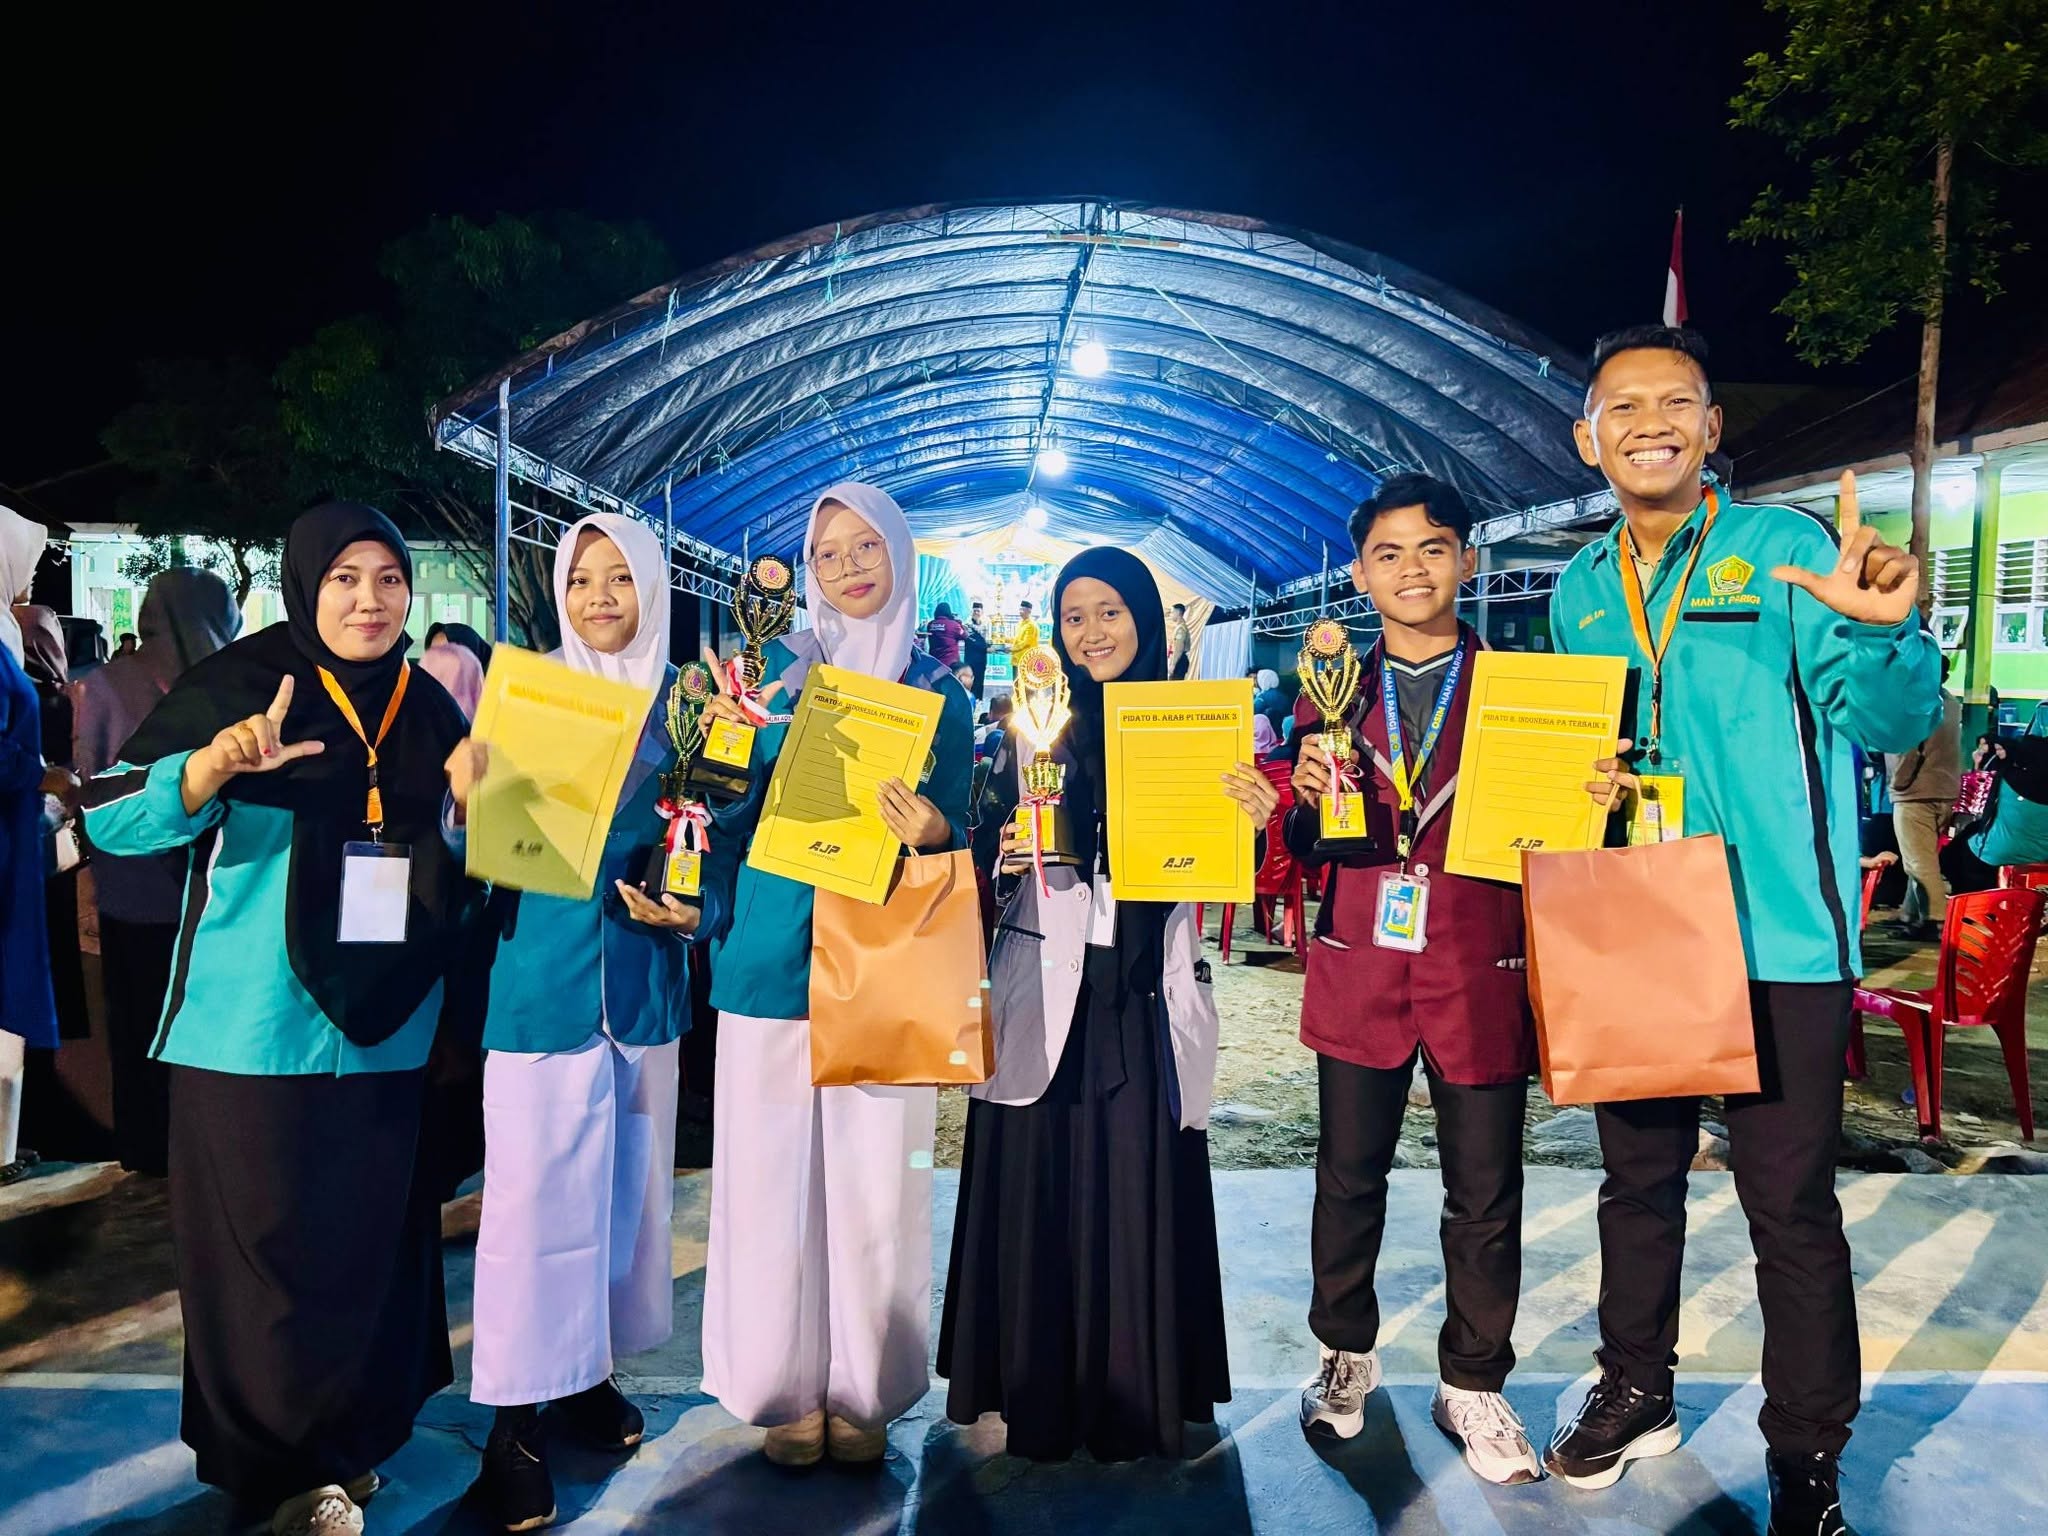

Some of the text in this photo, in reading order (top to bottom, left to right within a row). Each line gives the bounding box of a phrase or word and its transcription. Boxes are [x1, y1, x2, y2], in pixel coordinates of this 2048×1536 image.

[1690, 597, 1715, 608] MAN
[1718, 597, 1725, 605] 2
[1384, 672, 1394, 691] MAN
[1439, 684, 1454, 706] MAN
[1122, 714, 1151, 722] PIDATO
[1196, 713, 1230, 721] TERBAIK
[1568, 720, 1600, 729] TERBAIK
[808, 841, 841, 854] AJP
[1508, 837, 1545, 849] AJP
[1162, 857, 1195, 868] AJP
